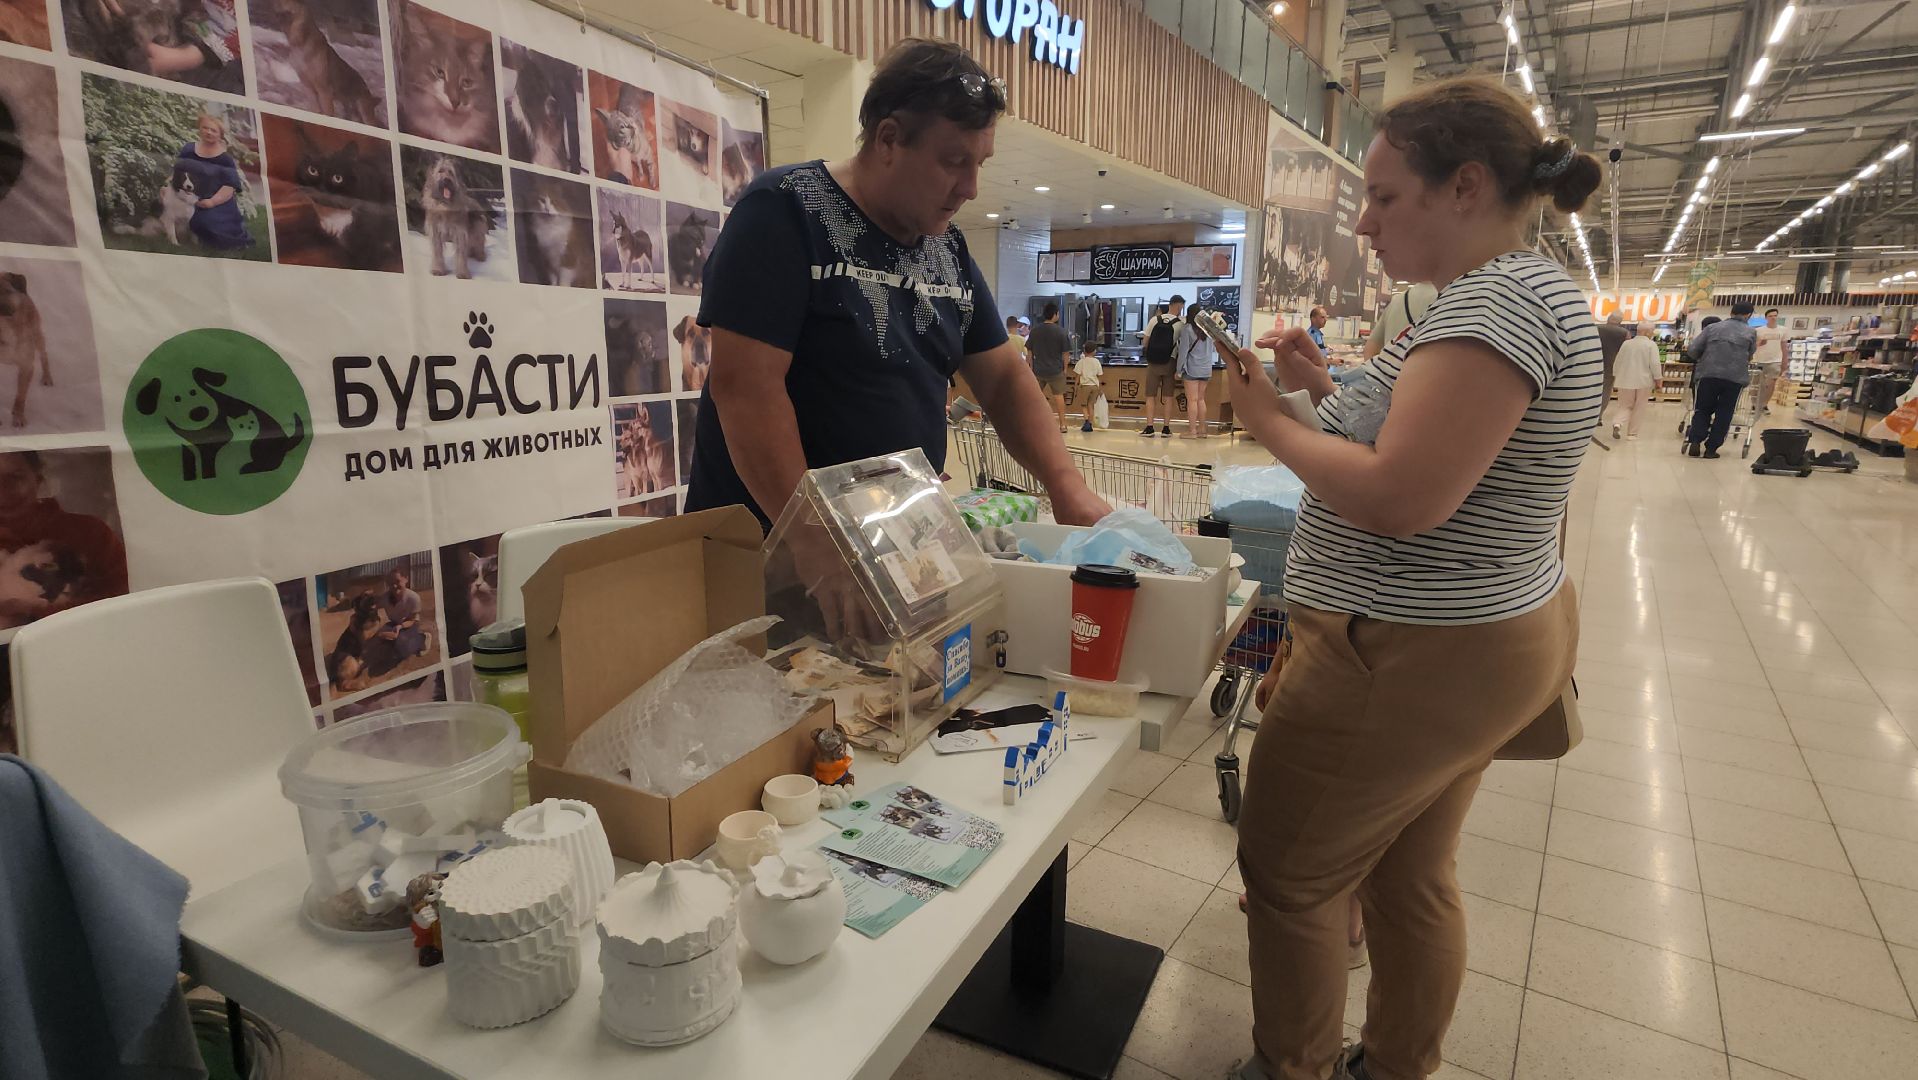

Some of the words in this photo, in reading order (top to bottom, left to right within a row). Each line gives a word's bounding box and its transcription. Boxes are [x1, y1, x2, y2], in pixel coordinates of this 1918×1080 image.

[856, 269, 874, 279] KEEP
[875, 272, 889, 282] OU
[1120, 257, 1163, 271] ШАУРМА
[332, 353, 600, 431] БУБАСТИ
[344, 446, 413, 482] ДОМ
[423, 440, 475, 471] ДЛЯ
[482, 426, 603, 460] ЖИВОТНЫХ
